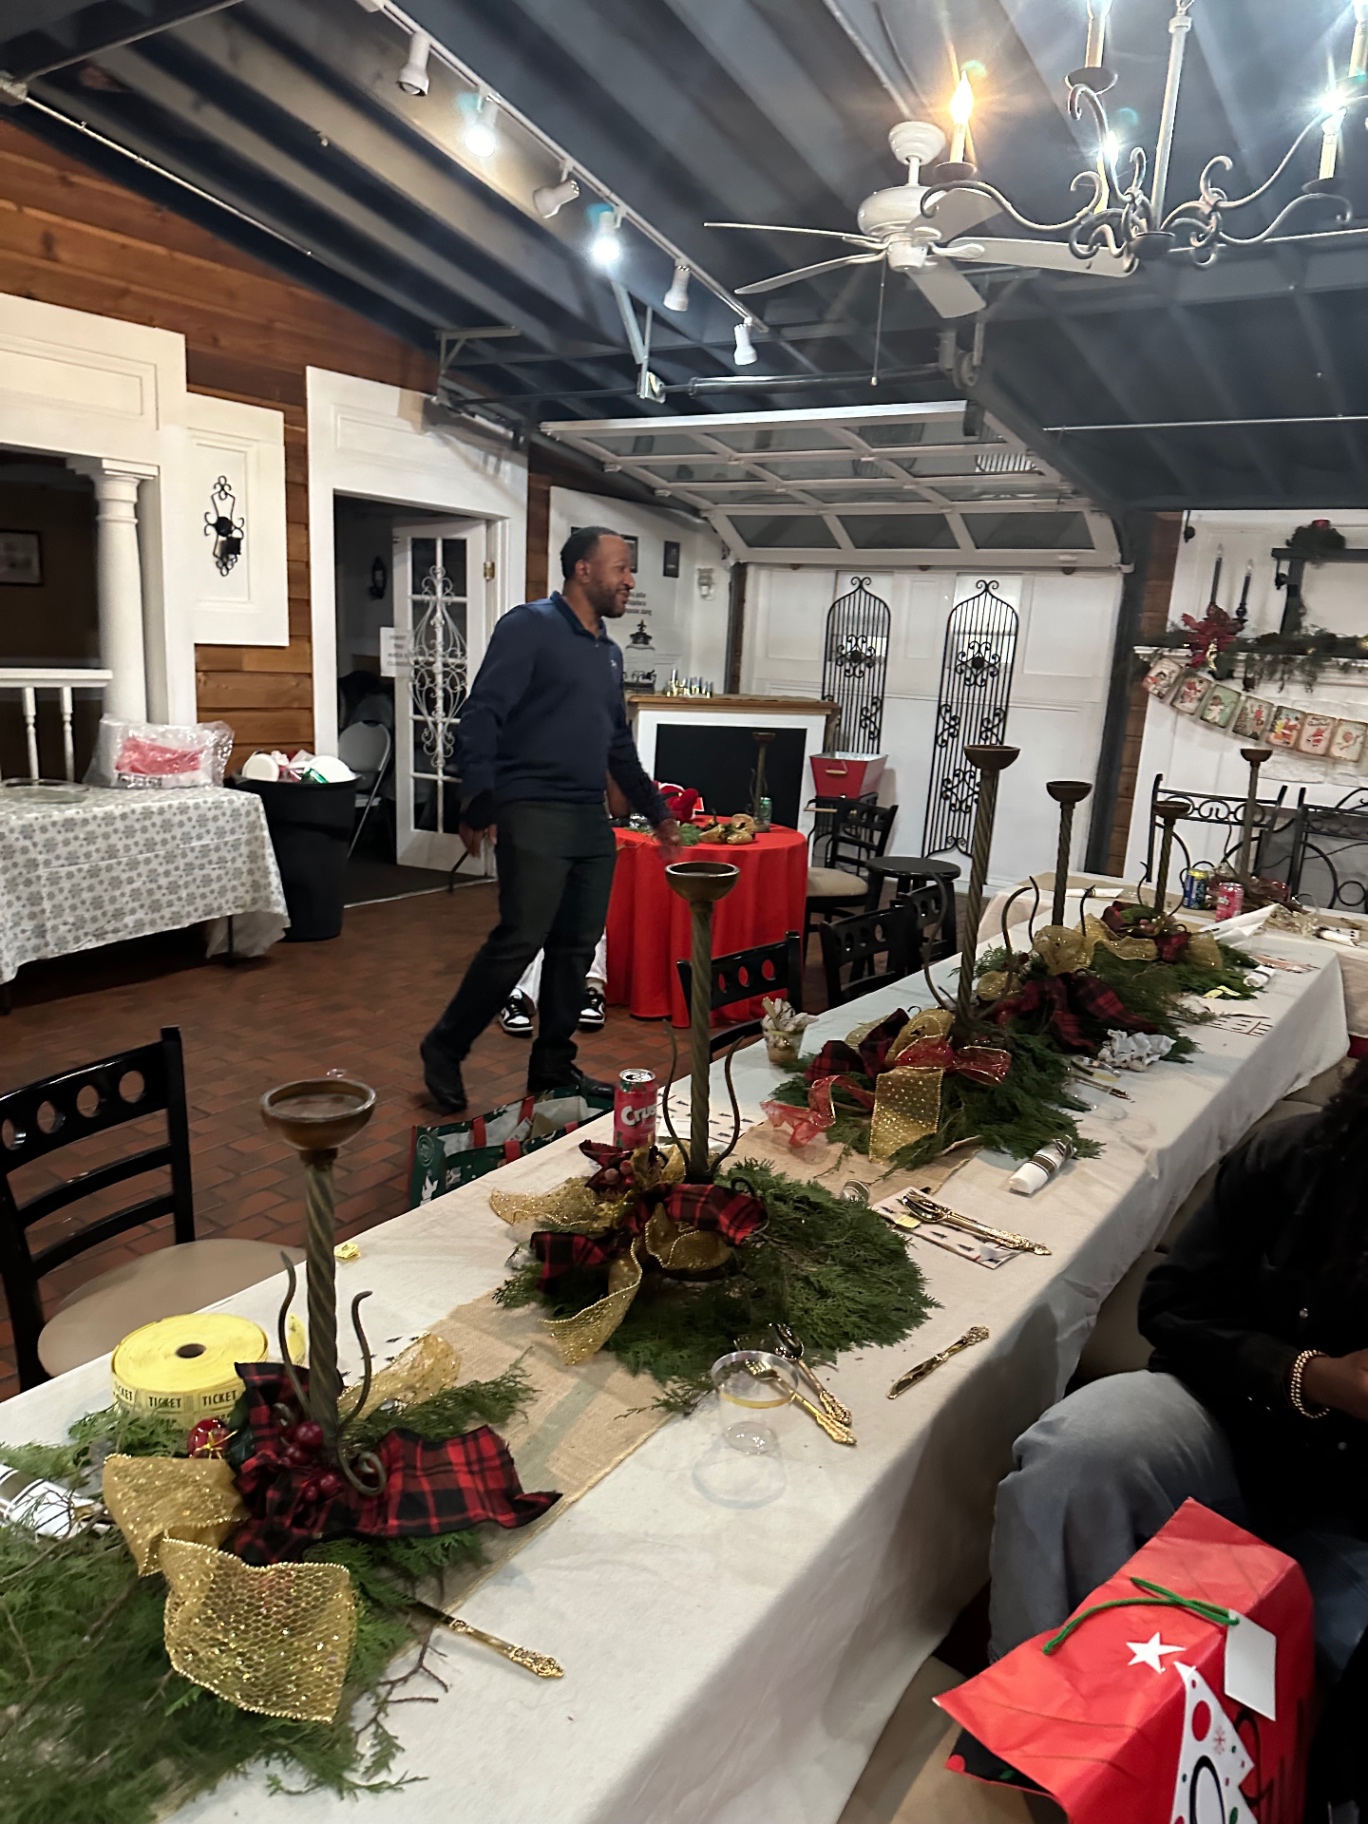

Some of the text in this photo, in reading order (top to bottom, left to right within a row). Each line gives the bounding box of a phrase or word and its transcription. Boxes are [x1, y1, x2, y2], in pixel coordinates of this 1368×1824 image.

[621, 1104, 657, 1126] Crus
[148, 1396, 182, 1408] TICKET
[202, 1389, 237, 1406] TICKET
